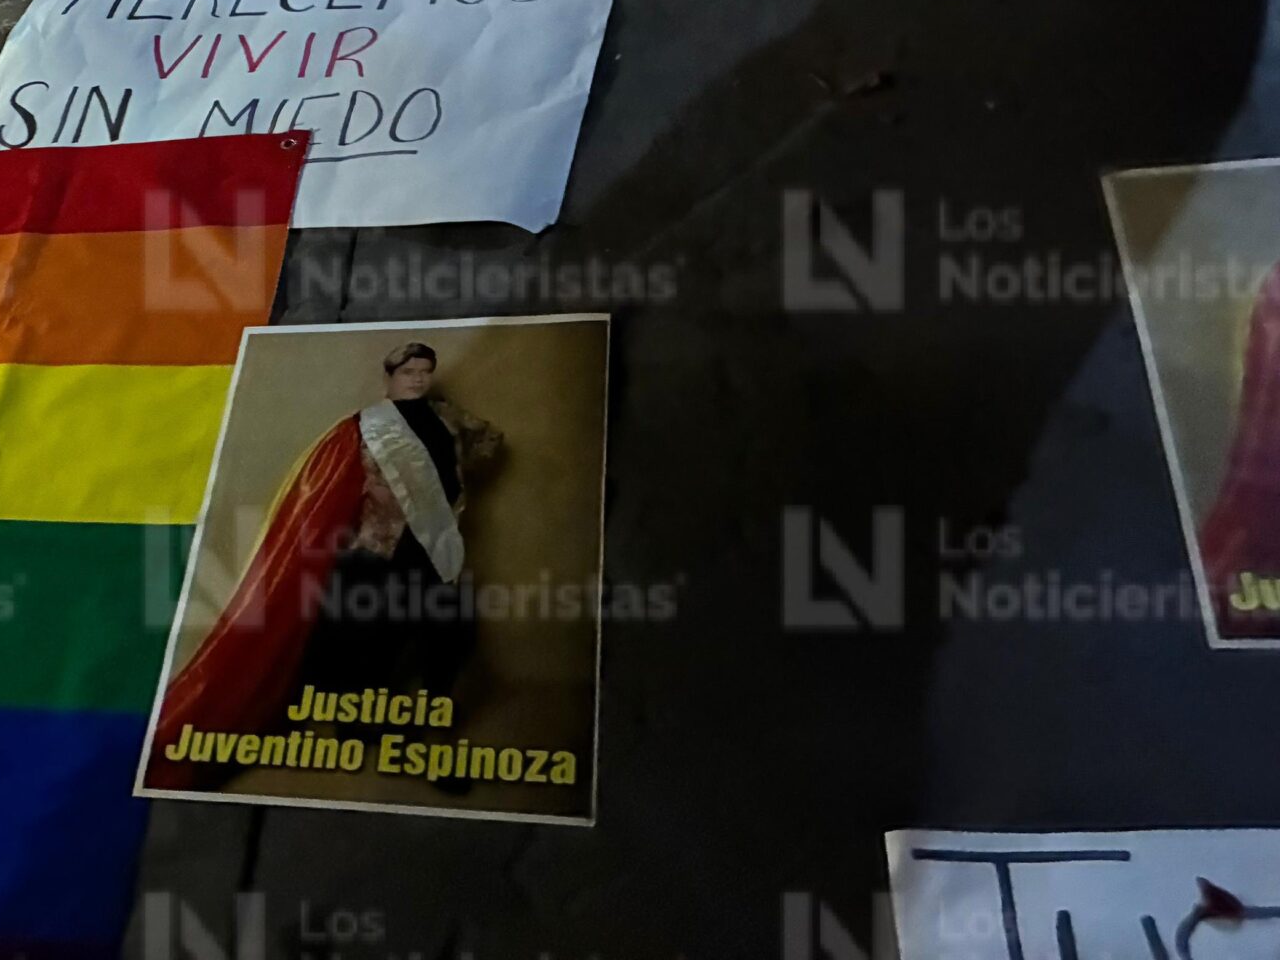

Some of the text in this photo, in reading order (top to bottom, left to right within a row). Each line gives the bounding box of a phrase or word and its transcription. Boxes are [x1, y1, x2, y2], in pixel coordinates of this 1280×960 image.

[153, 27, 379, 80] VIVIR
[200, 88, 443, 147] MIEDO
[287, 684, 453, 728] Justicia
[165, 724, 576, 785] Juventino Espinoza
